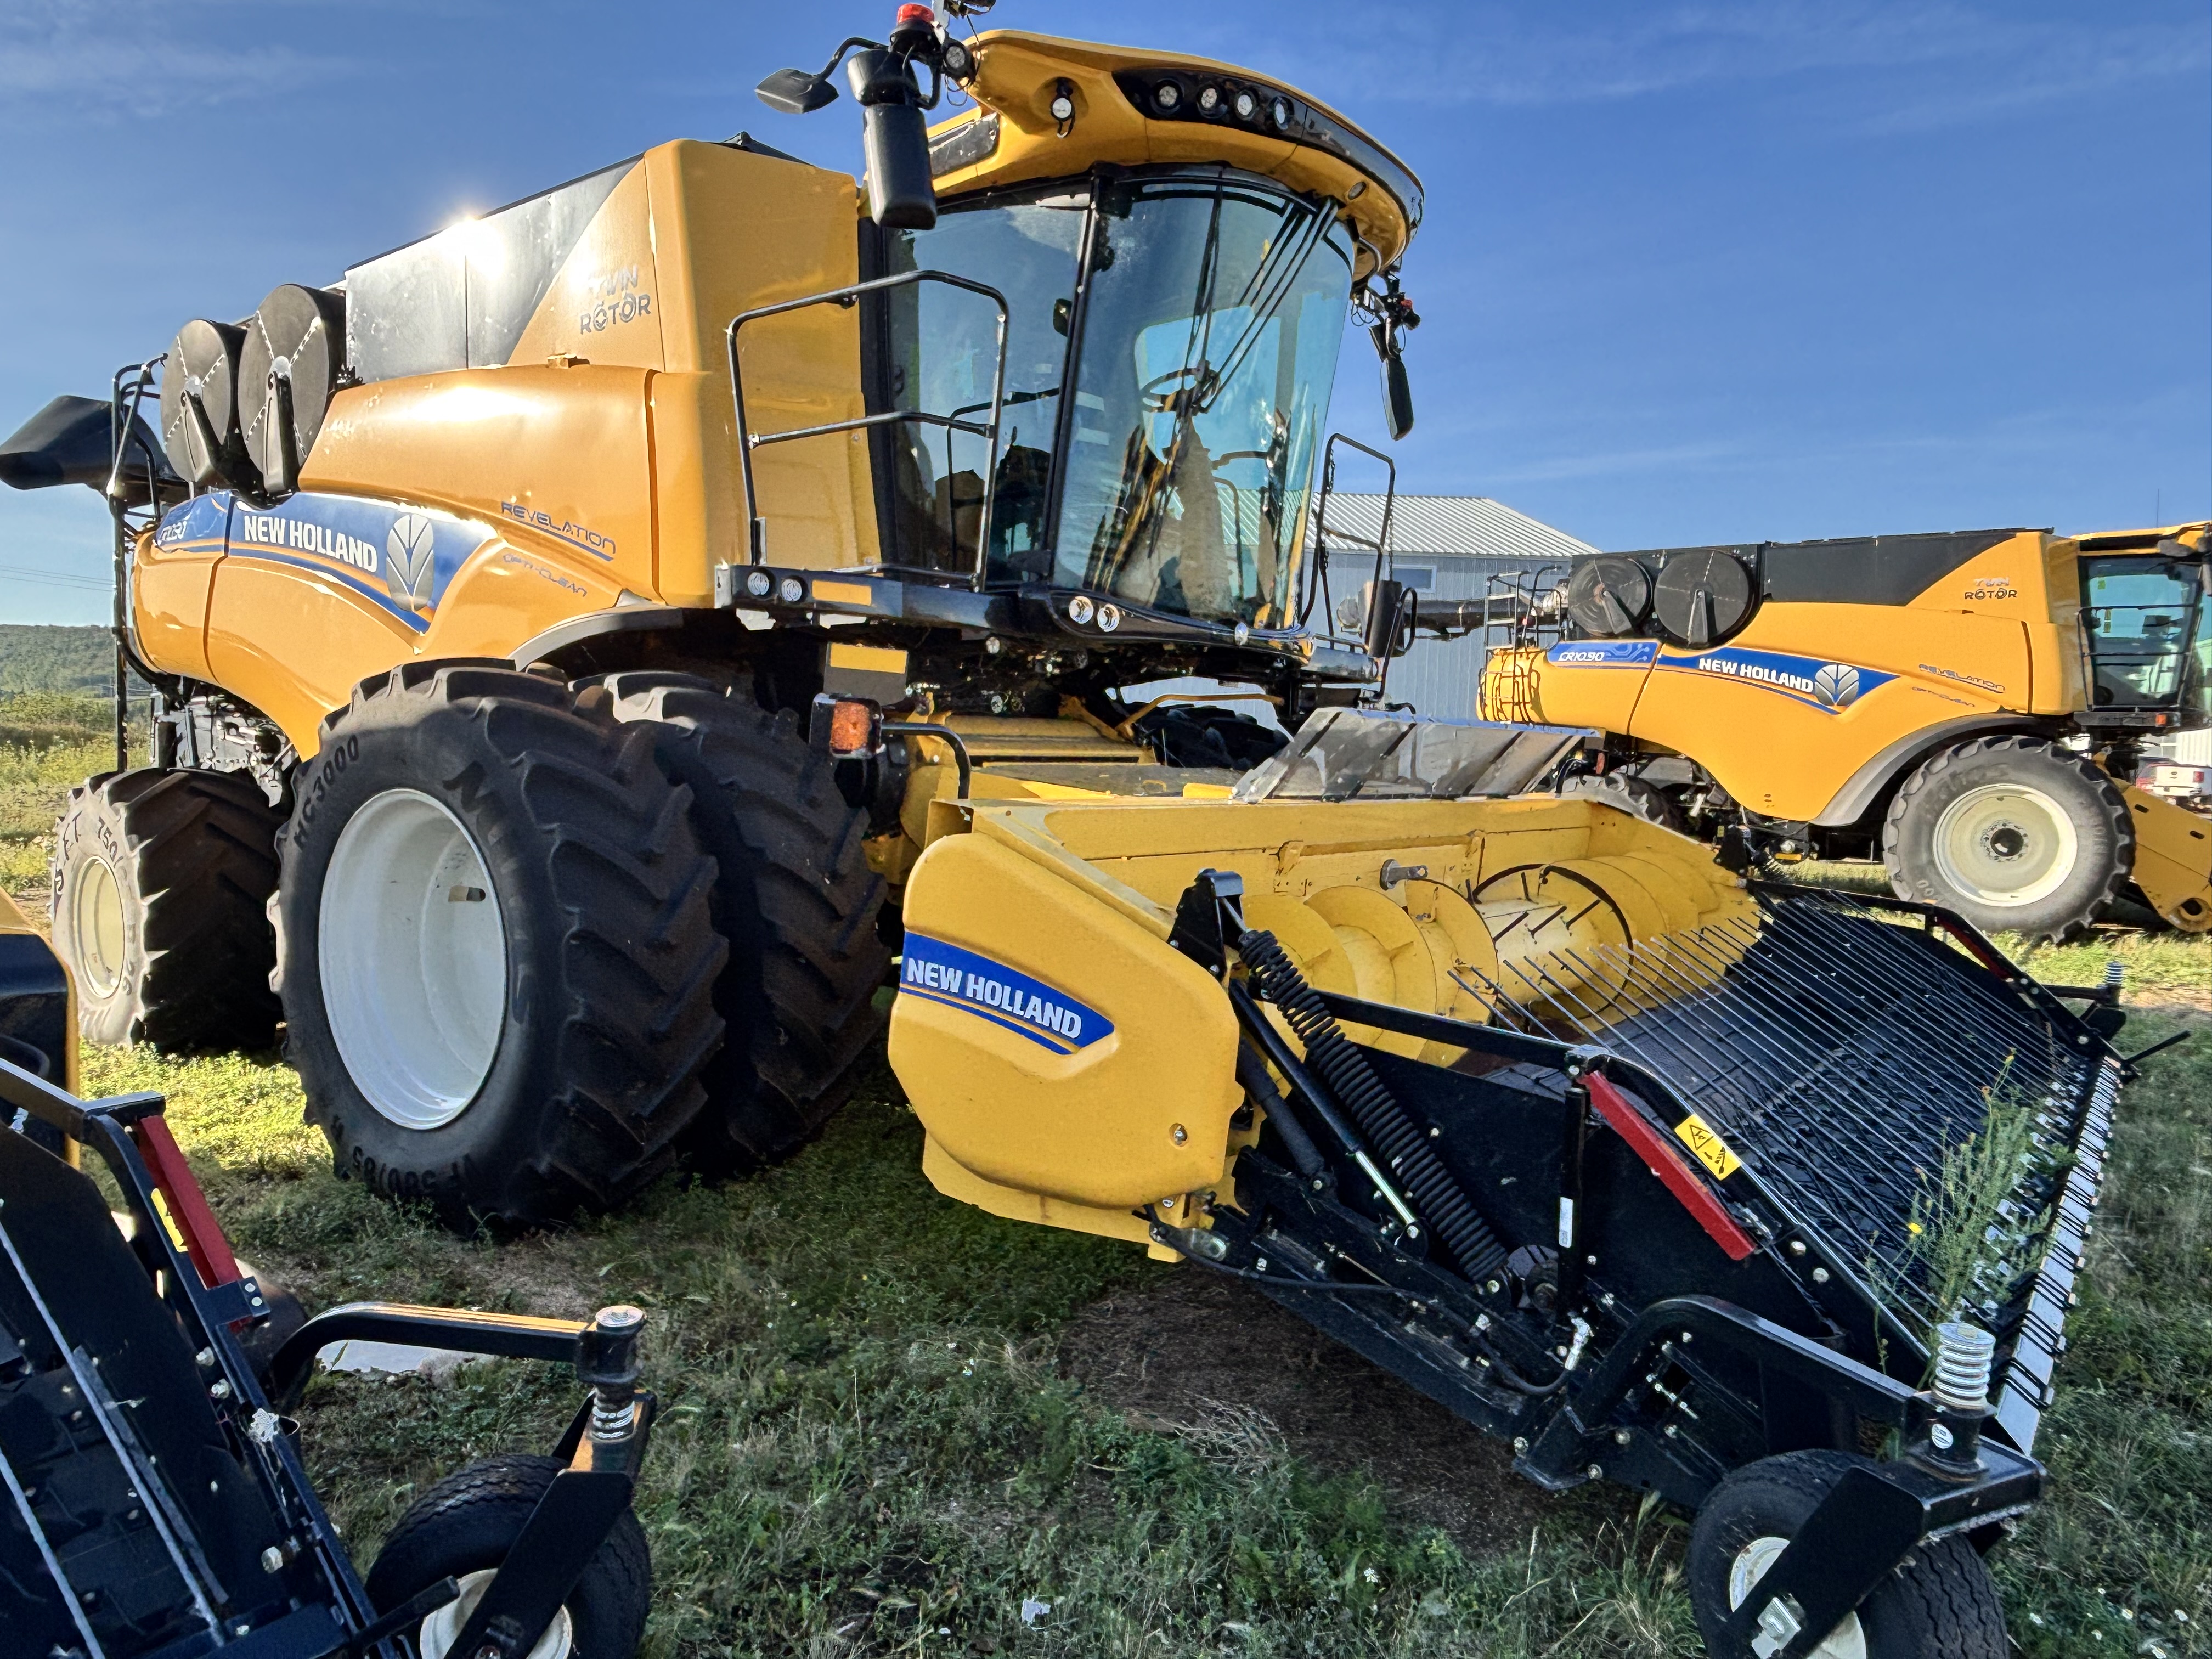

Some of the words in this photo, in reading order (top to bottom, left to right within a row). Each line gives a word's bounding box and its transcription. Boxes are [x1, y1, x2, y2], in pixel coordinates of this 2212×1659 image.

[580, 293, 651, 335] ROTOR
[244, 515, 286, 544] NEW
[289, 520, 377, 573] HOLLAND
[501, 501, 616, 554] REVELATION
[1964, 588, 2018, 600] ROTOR
[1699, 658, 1737, 674] NEW
[1740, 663, 1814, 693] HOLLAND
[907, 958, 962, 993] NEW
[966, 973, 1082, 1039] HOLLAND
